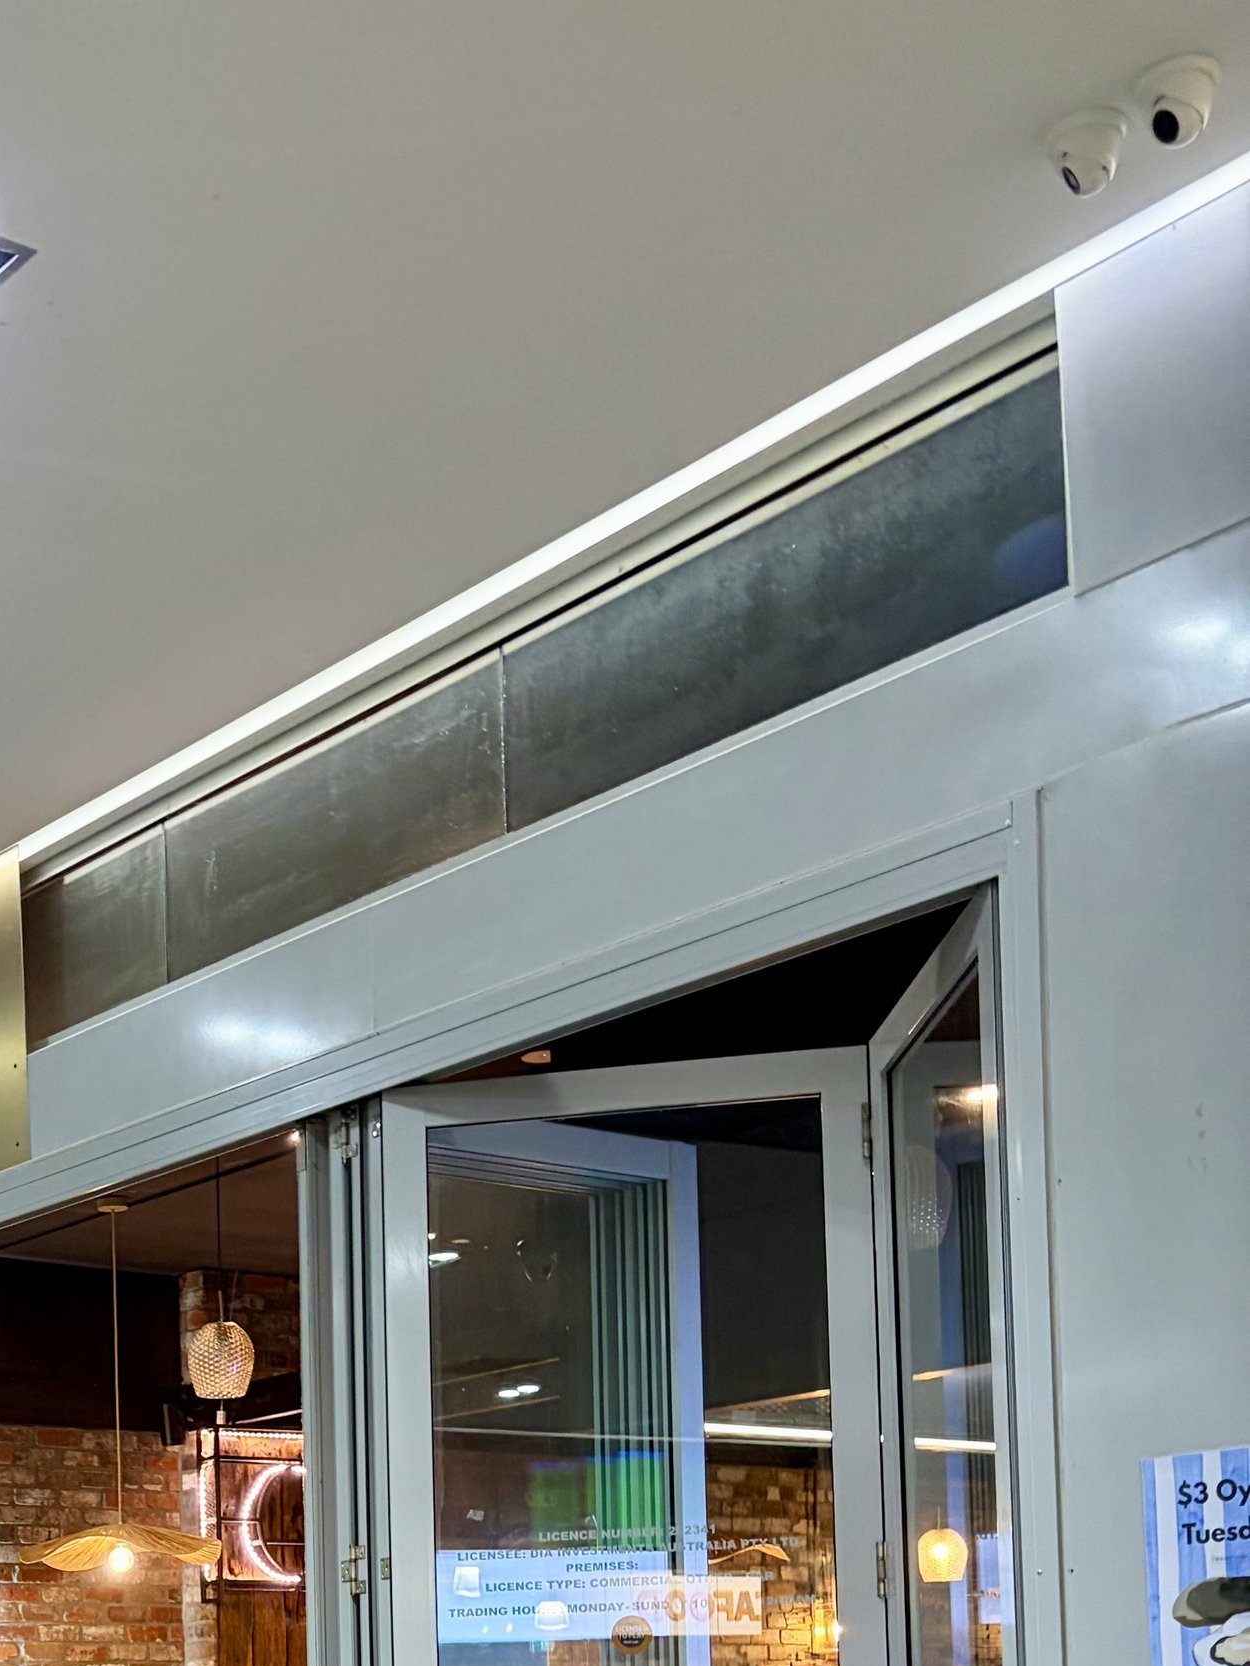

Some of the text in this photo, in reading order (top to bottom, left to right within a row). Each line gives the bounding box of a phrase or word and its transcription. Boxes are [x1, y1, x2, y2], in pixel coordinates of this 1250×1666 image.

[1178, 1480, 1209, 1509] $3
[539, 1529, 597, 1542] LICENCE
[457, 1550, 527, 1562] LICENSEE:
[566, 1560, 639, 1572] PREMISES:
[485, 1581, 543, 1592] LICENCE
[547, 1579, 586, 1590] TYPE:
[448, 1606, 508, 1618] TRADING
